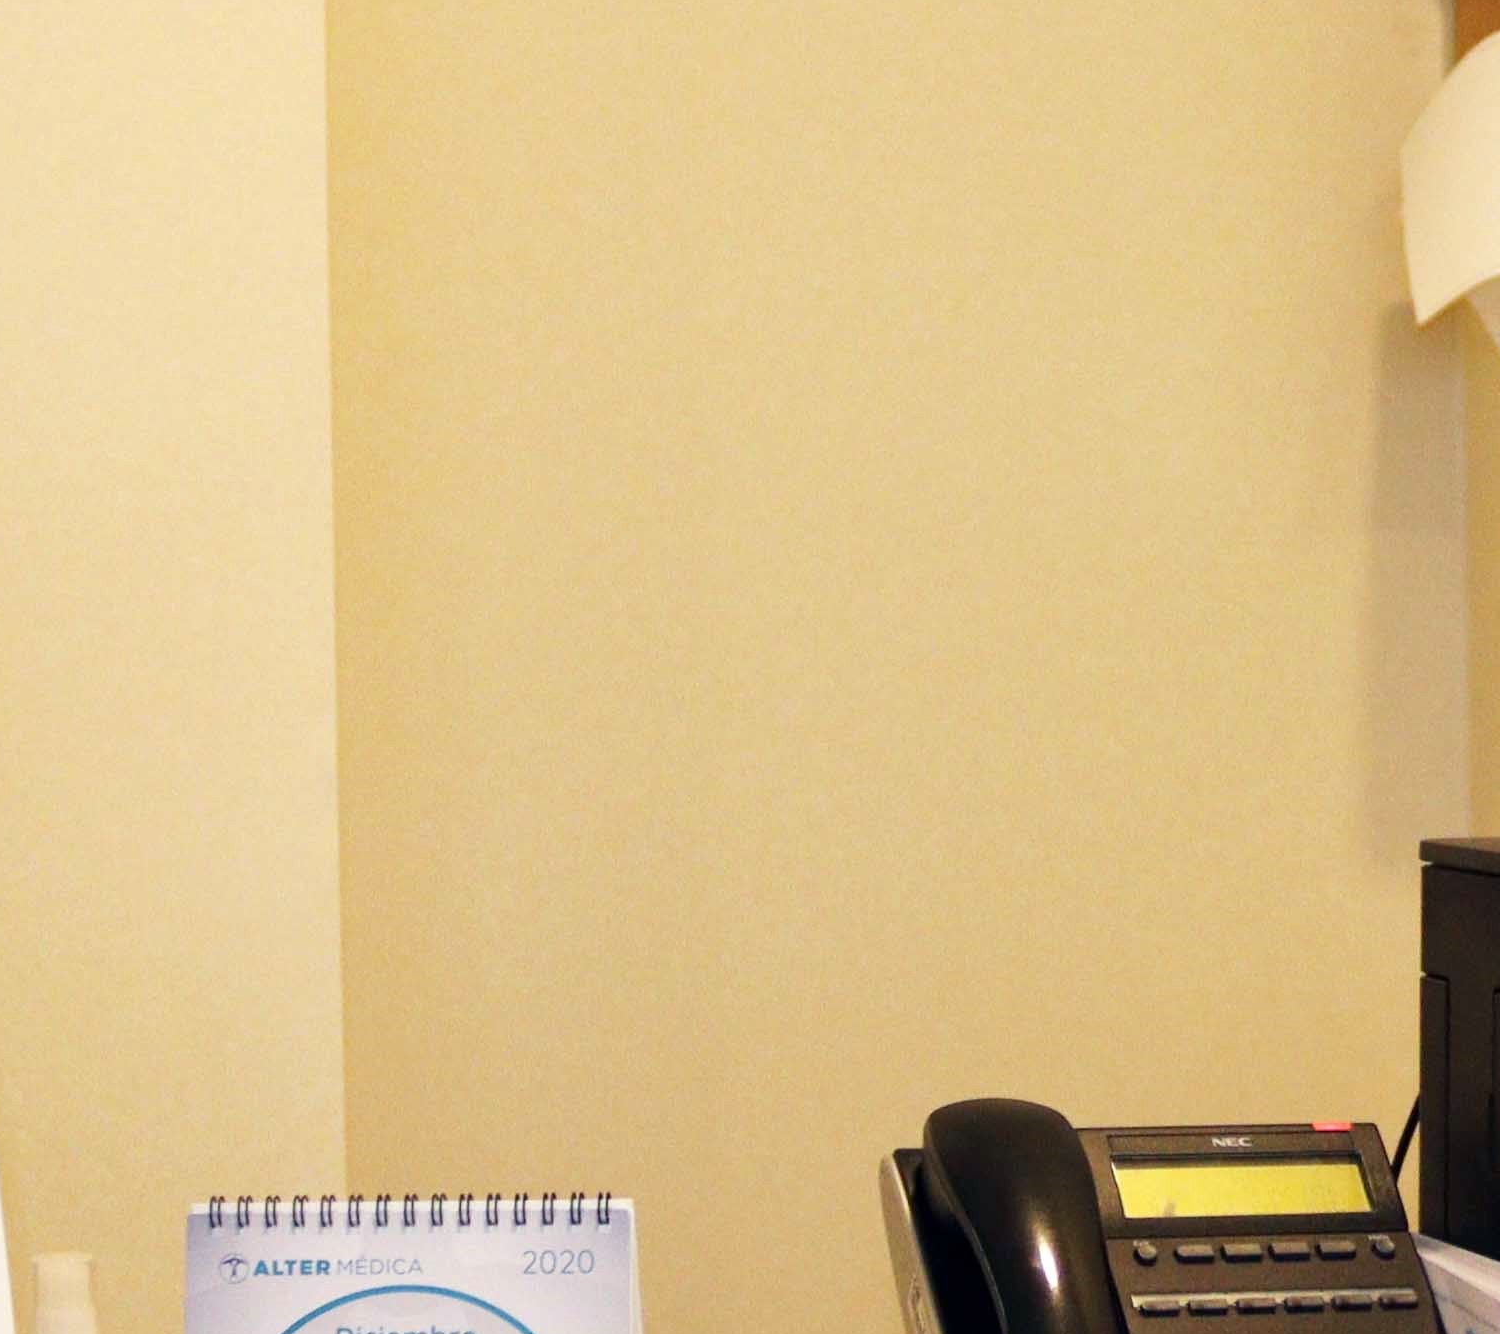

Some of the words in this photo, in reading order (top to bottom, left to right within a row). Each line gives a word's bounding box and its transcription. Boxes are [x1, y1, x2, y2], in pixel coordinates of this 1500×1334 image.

[1211, 1137, 1252, 1148] NEC
[253, 1258, 330, 1276] ALTER
[336, 1255, 423, 1276] MÉDICA
[521, 1249, 595, 1275] 2020
